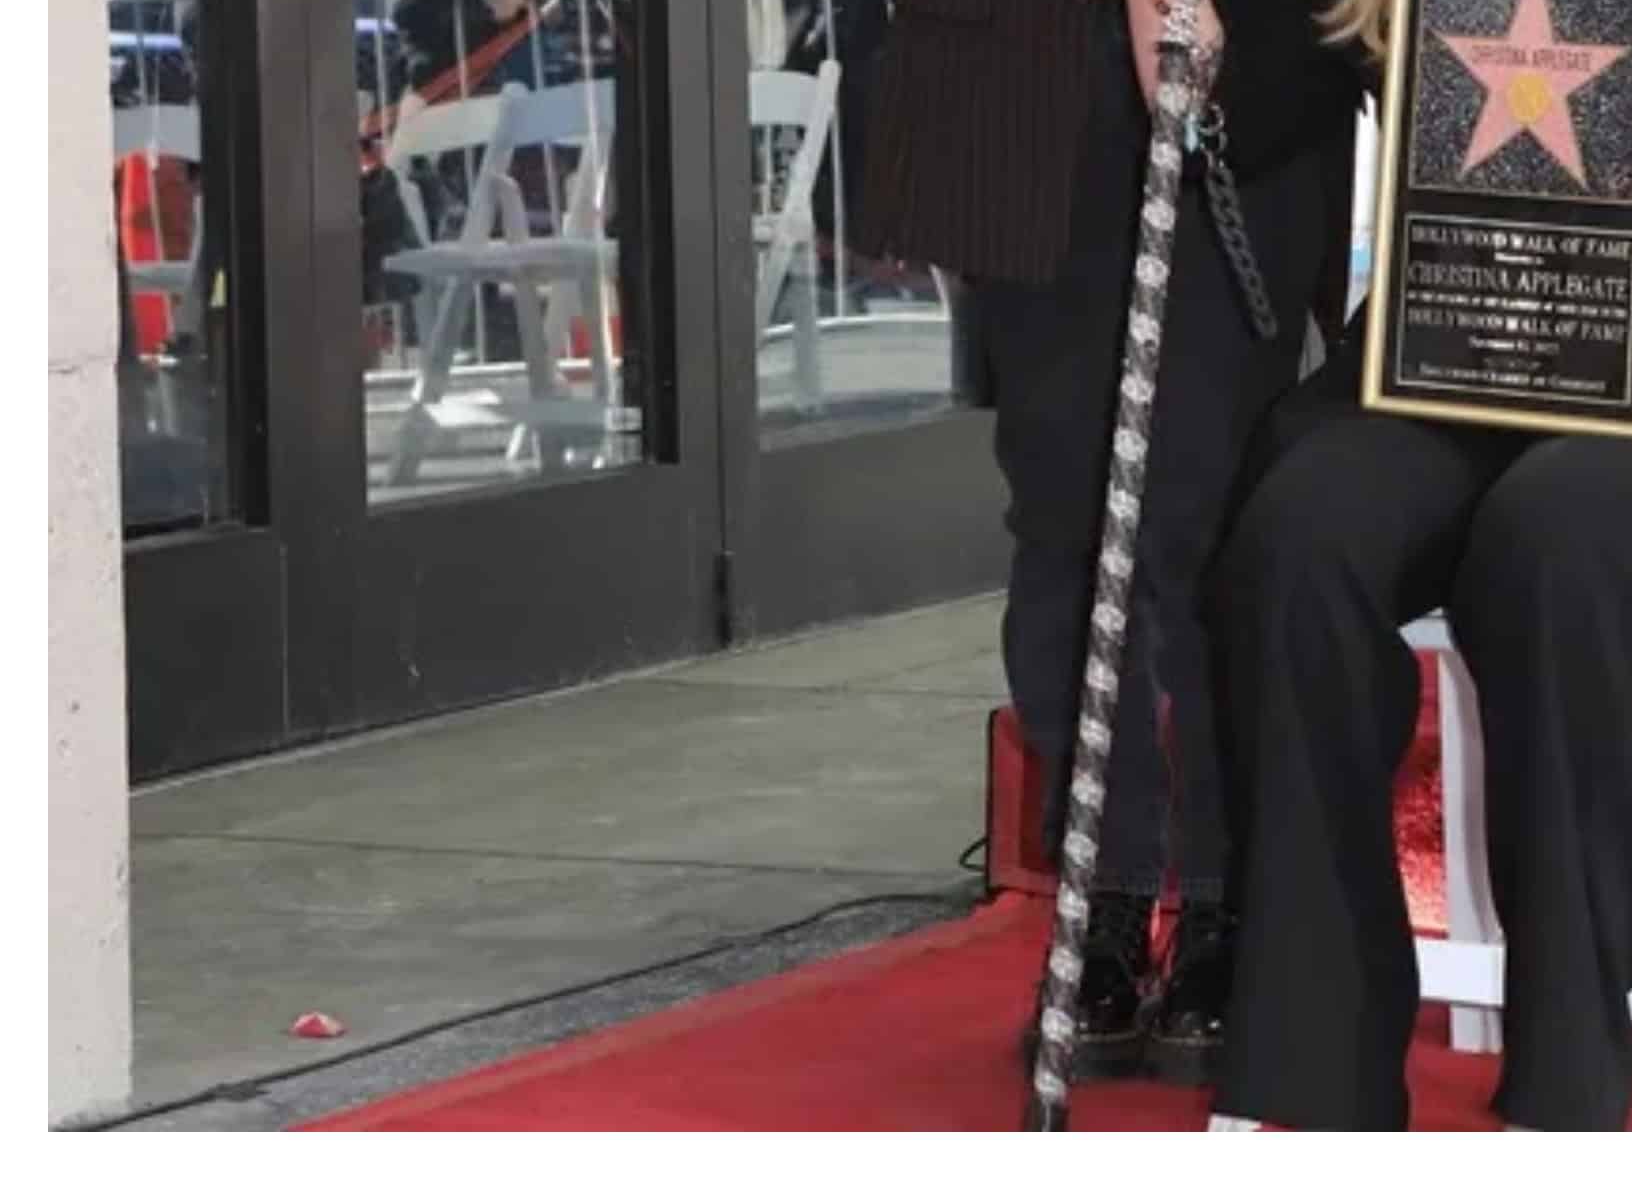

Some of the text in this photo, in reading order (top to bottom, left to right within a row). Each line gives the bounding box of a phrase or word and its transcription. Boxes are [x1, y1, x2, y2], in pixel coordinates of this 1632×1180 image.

[1411, 225, 1632, 260] HOLLYWOOD WALK OF FAME
[1408, 261, 1629, 301] CHRISTINA APPLEGATE
[1407, 306, 1626, 344] HOLLYWOOD WALK OF FAME
